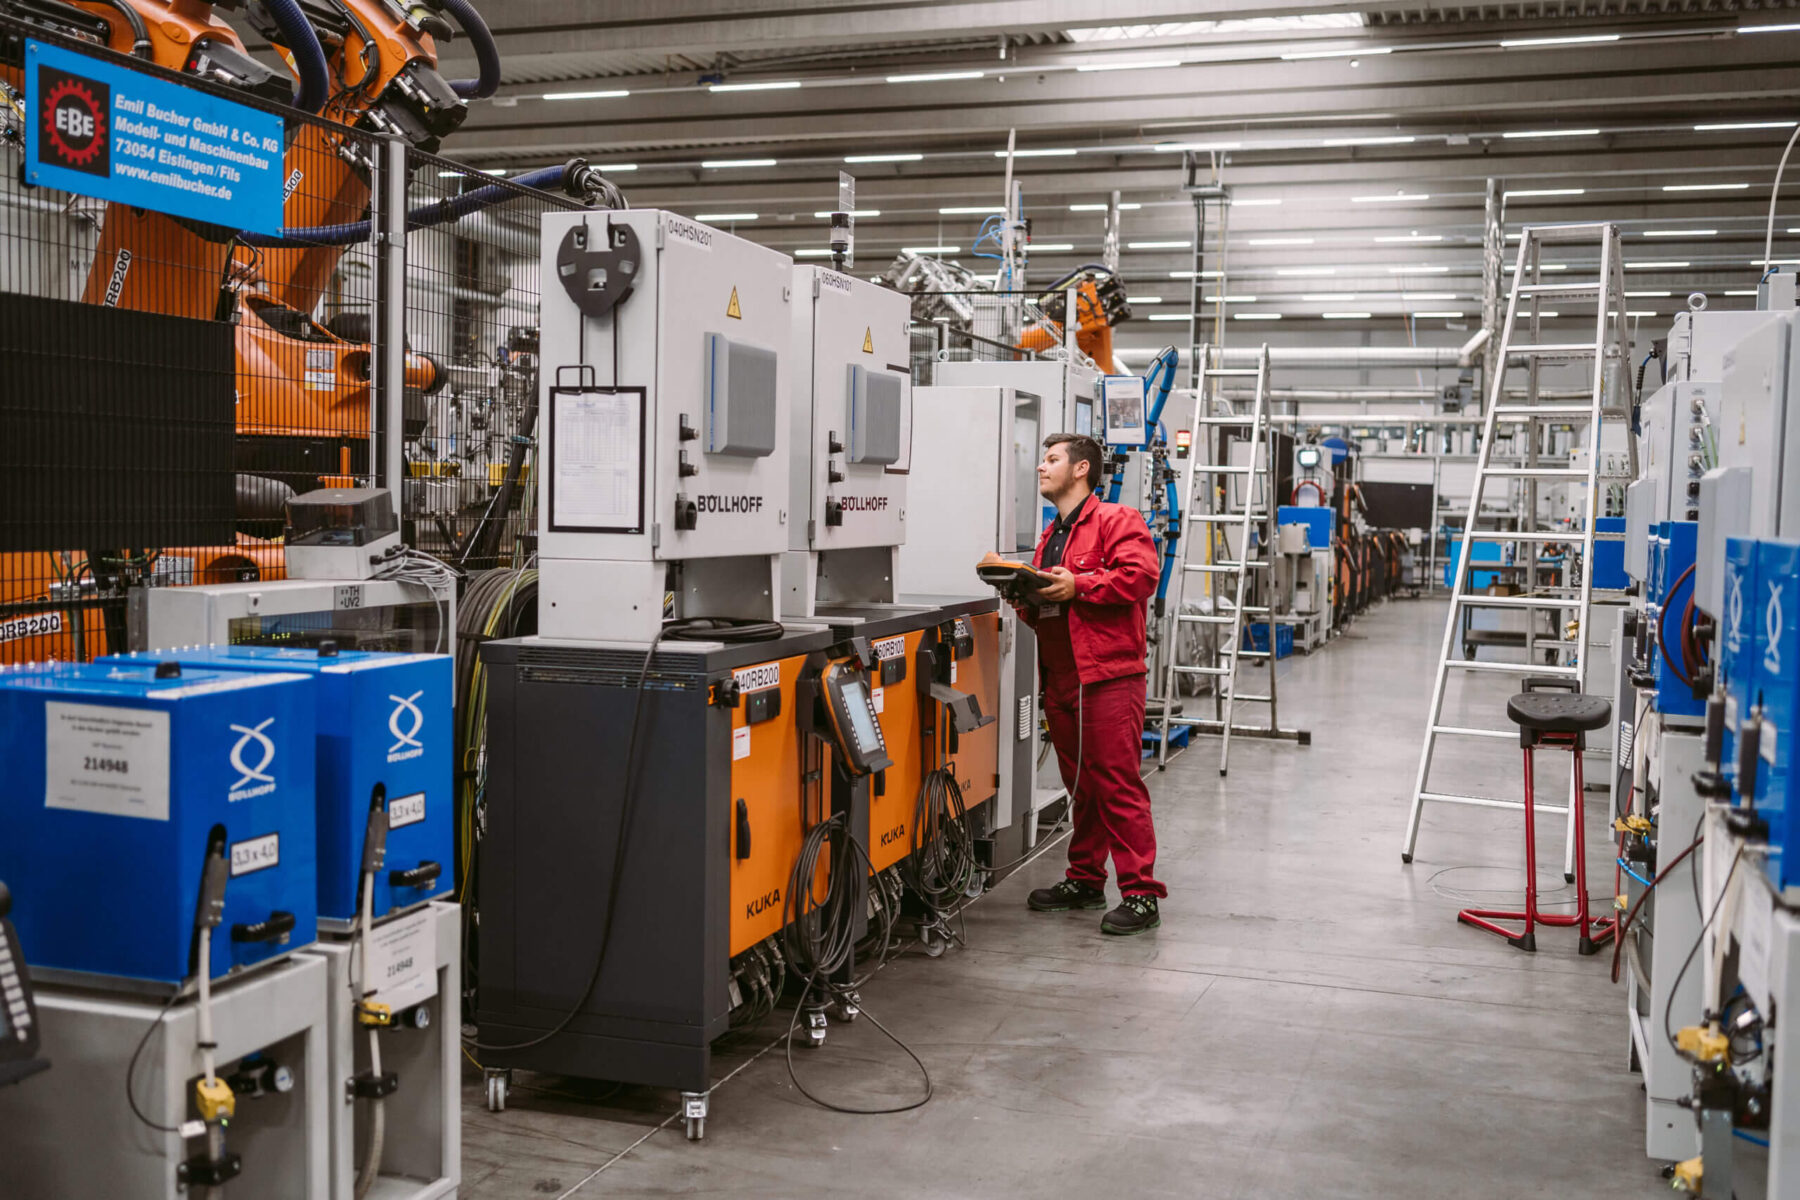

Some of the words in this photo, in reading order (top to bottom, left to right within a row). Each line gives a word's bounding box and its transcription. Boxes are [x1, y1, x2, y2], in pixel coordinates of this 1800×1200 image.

[56, 107, 94, 137] EBE
[114, 93, 144, 115] Emil
[147, 103, 191, 128] Bucher
[193, 117, 228, 138] GmbH
[230, 128, 239, 142] &
[242, 131, 260, 148] Co.
[262, 137, 279, 153] KG
[114, 116, 161, 140] Modell-
[164, 132, 187, 148] und
[189, 136, 269, 170] Maschinenbau
[115, 138, 156, 160] 73054
[114, 163, 232, 201] www.emilbucher.de
[283, 170, 302, 201] B100
[668, 219, 713, 248] 040HSN201
[105, 250, 131, 306] RB200
[697, 494, 763, 513] BÖLLHOFF
[875, 639, 905, 659] 60RB100
[84, 756, 128, 774] 214948
[880, 824, 905, 847] KUKA
[746, 888, 781, 919] KUKA
